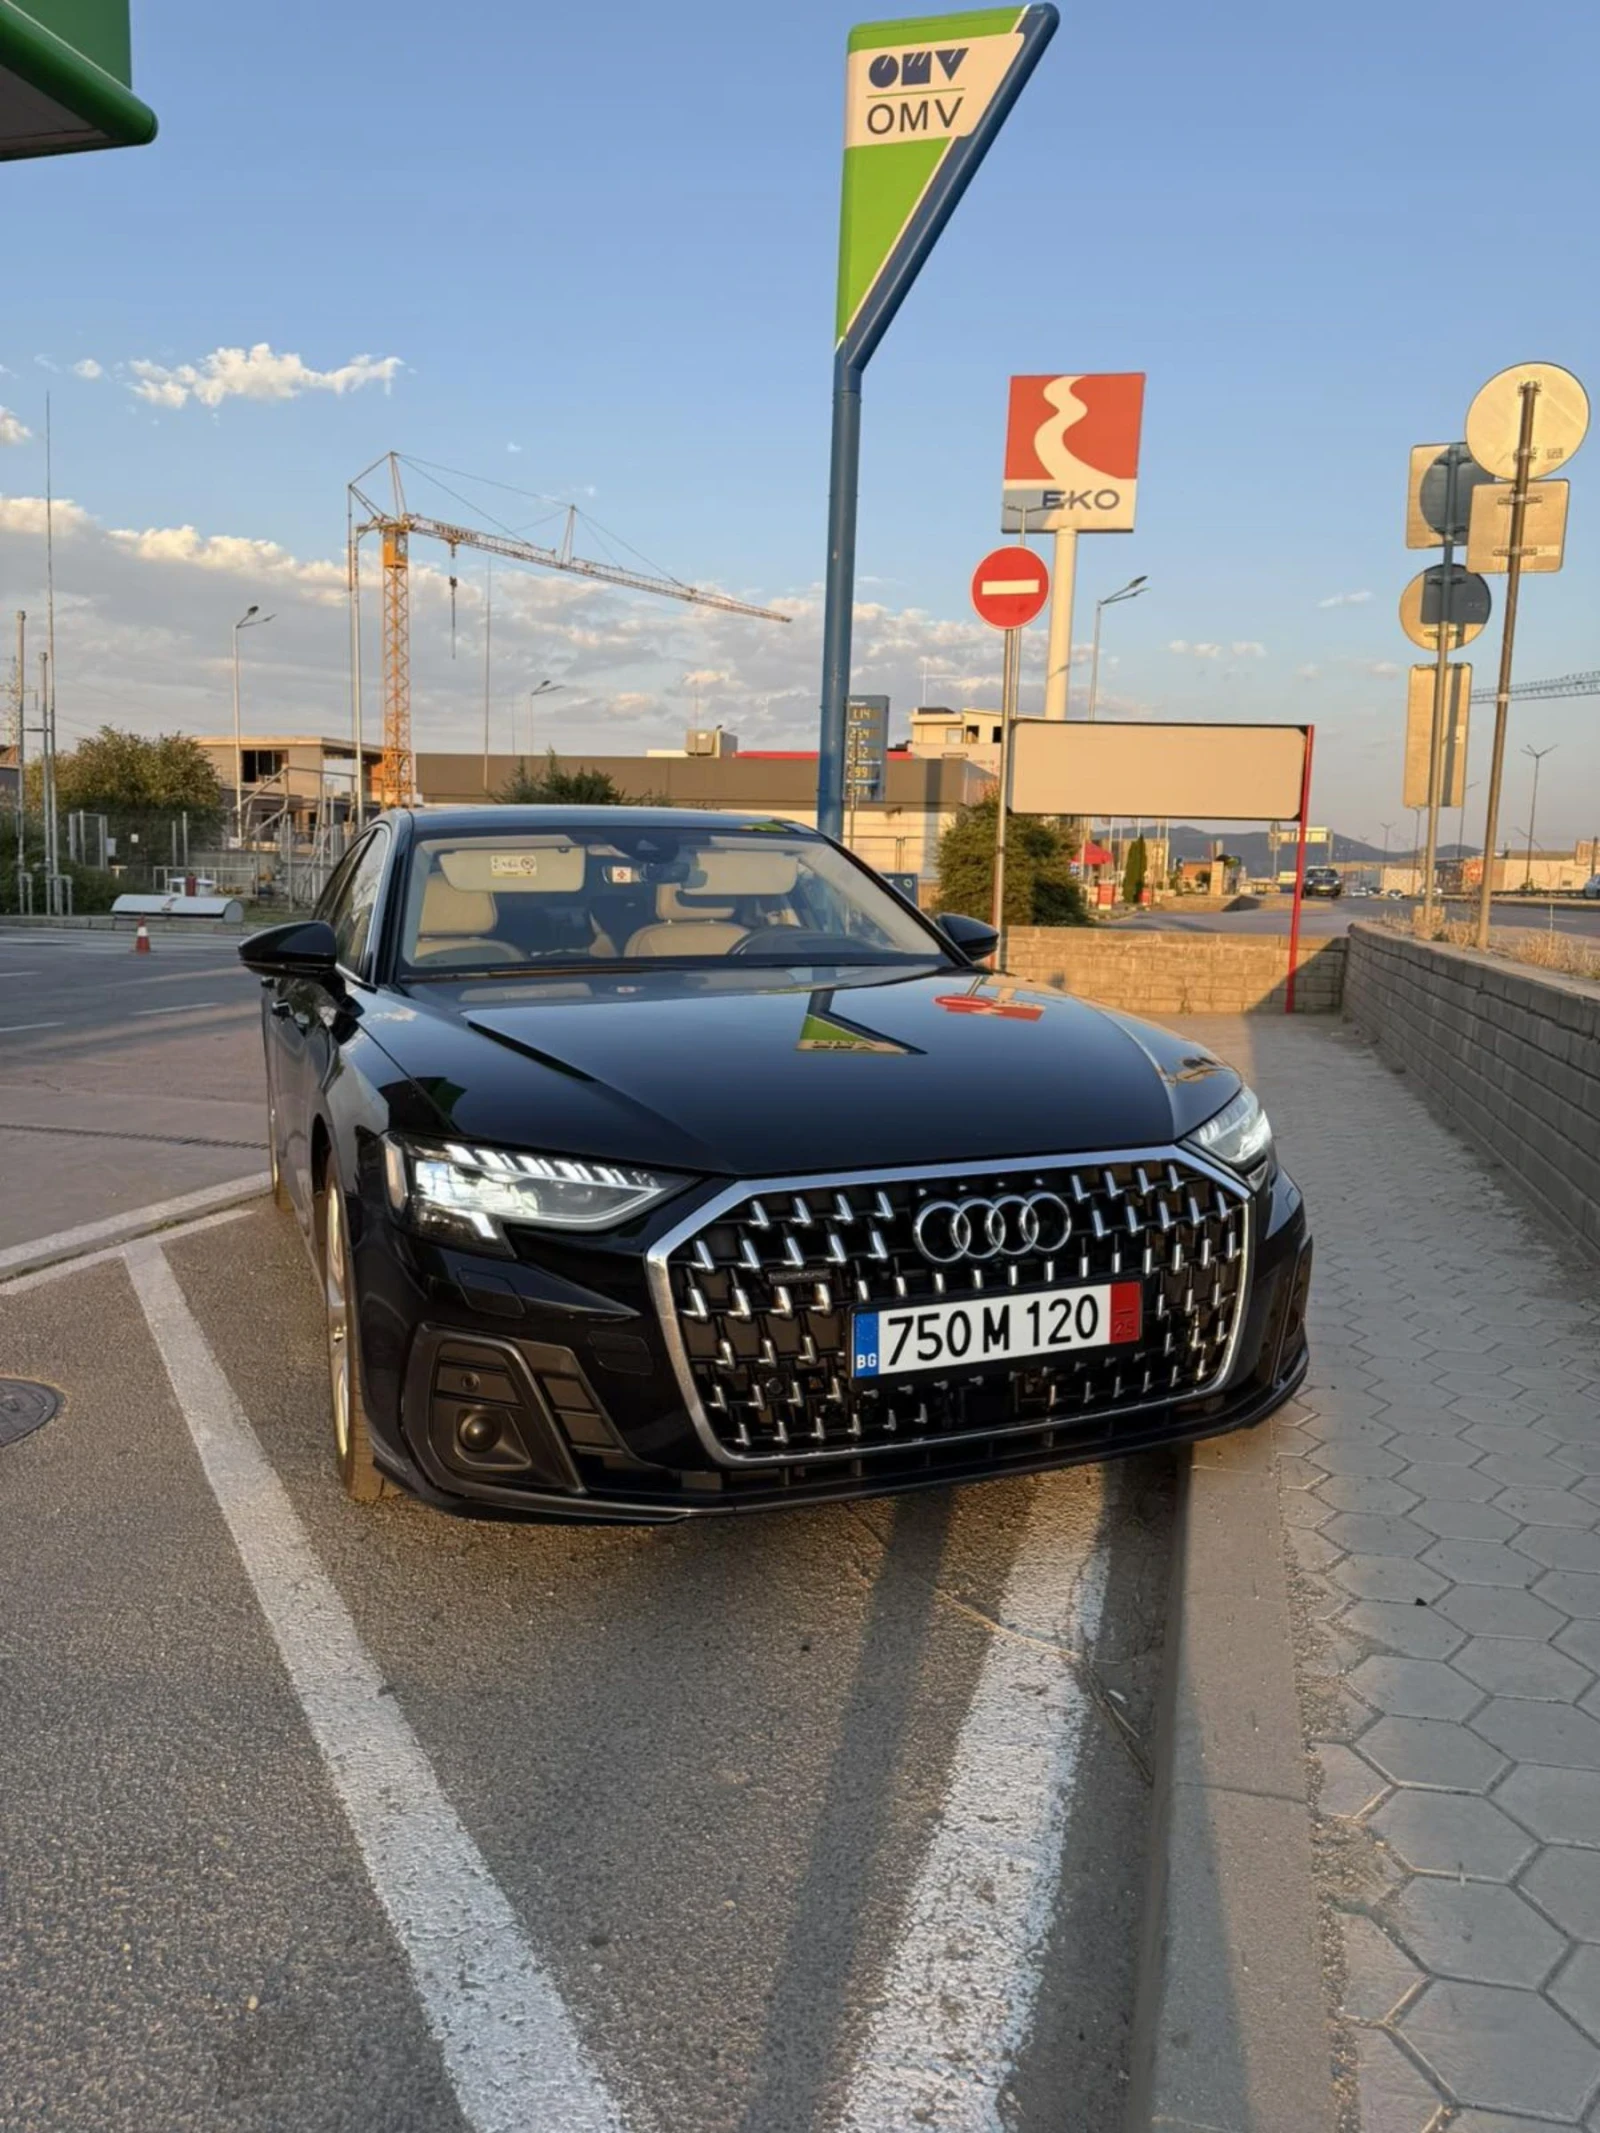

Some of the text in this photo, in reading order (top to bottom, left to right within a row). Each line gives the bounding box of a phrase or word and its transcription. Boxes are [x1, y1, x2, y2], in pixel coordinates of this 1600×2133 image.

[867, 97, 964, 135] OMV
[1041, 489, 1120, 510] EKO
[888, 1293, 1099, 1366] 750 M 120
[856, 1353, 877, 1369] BG
